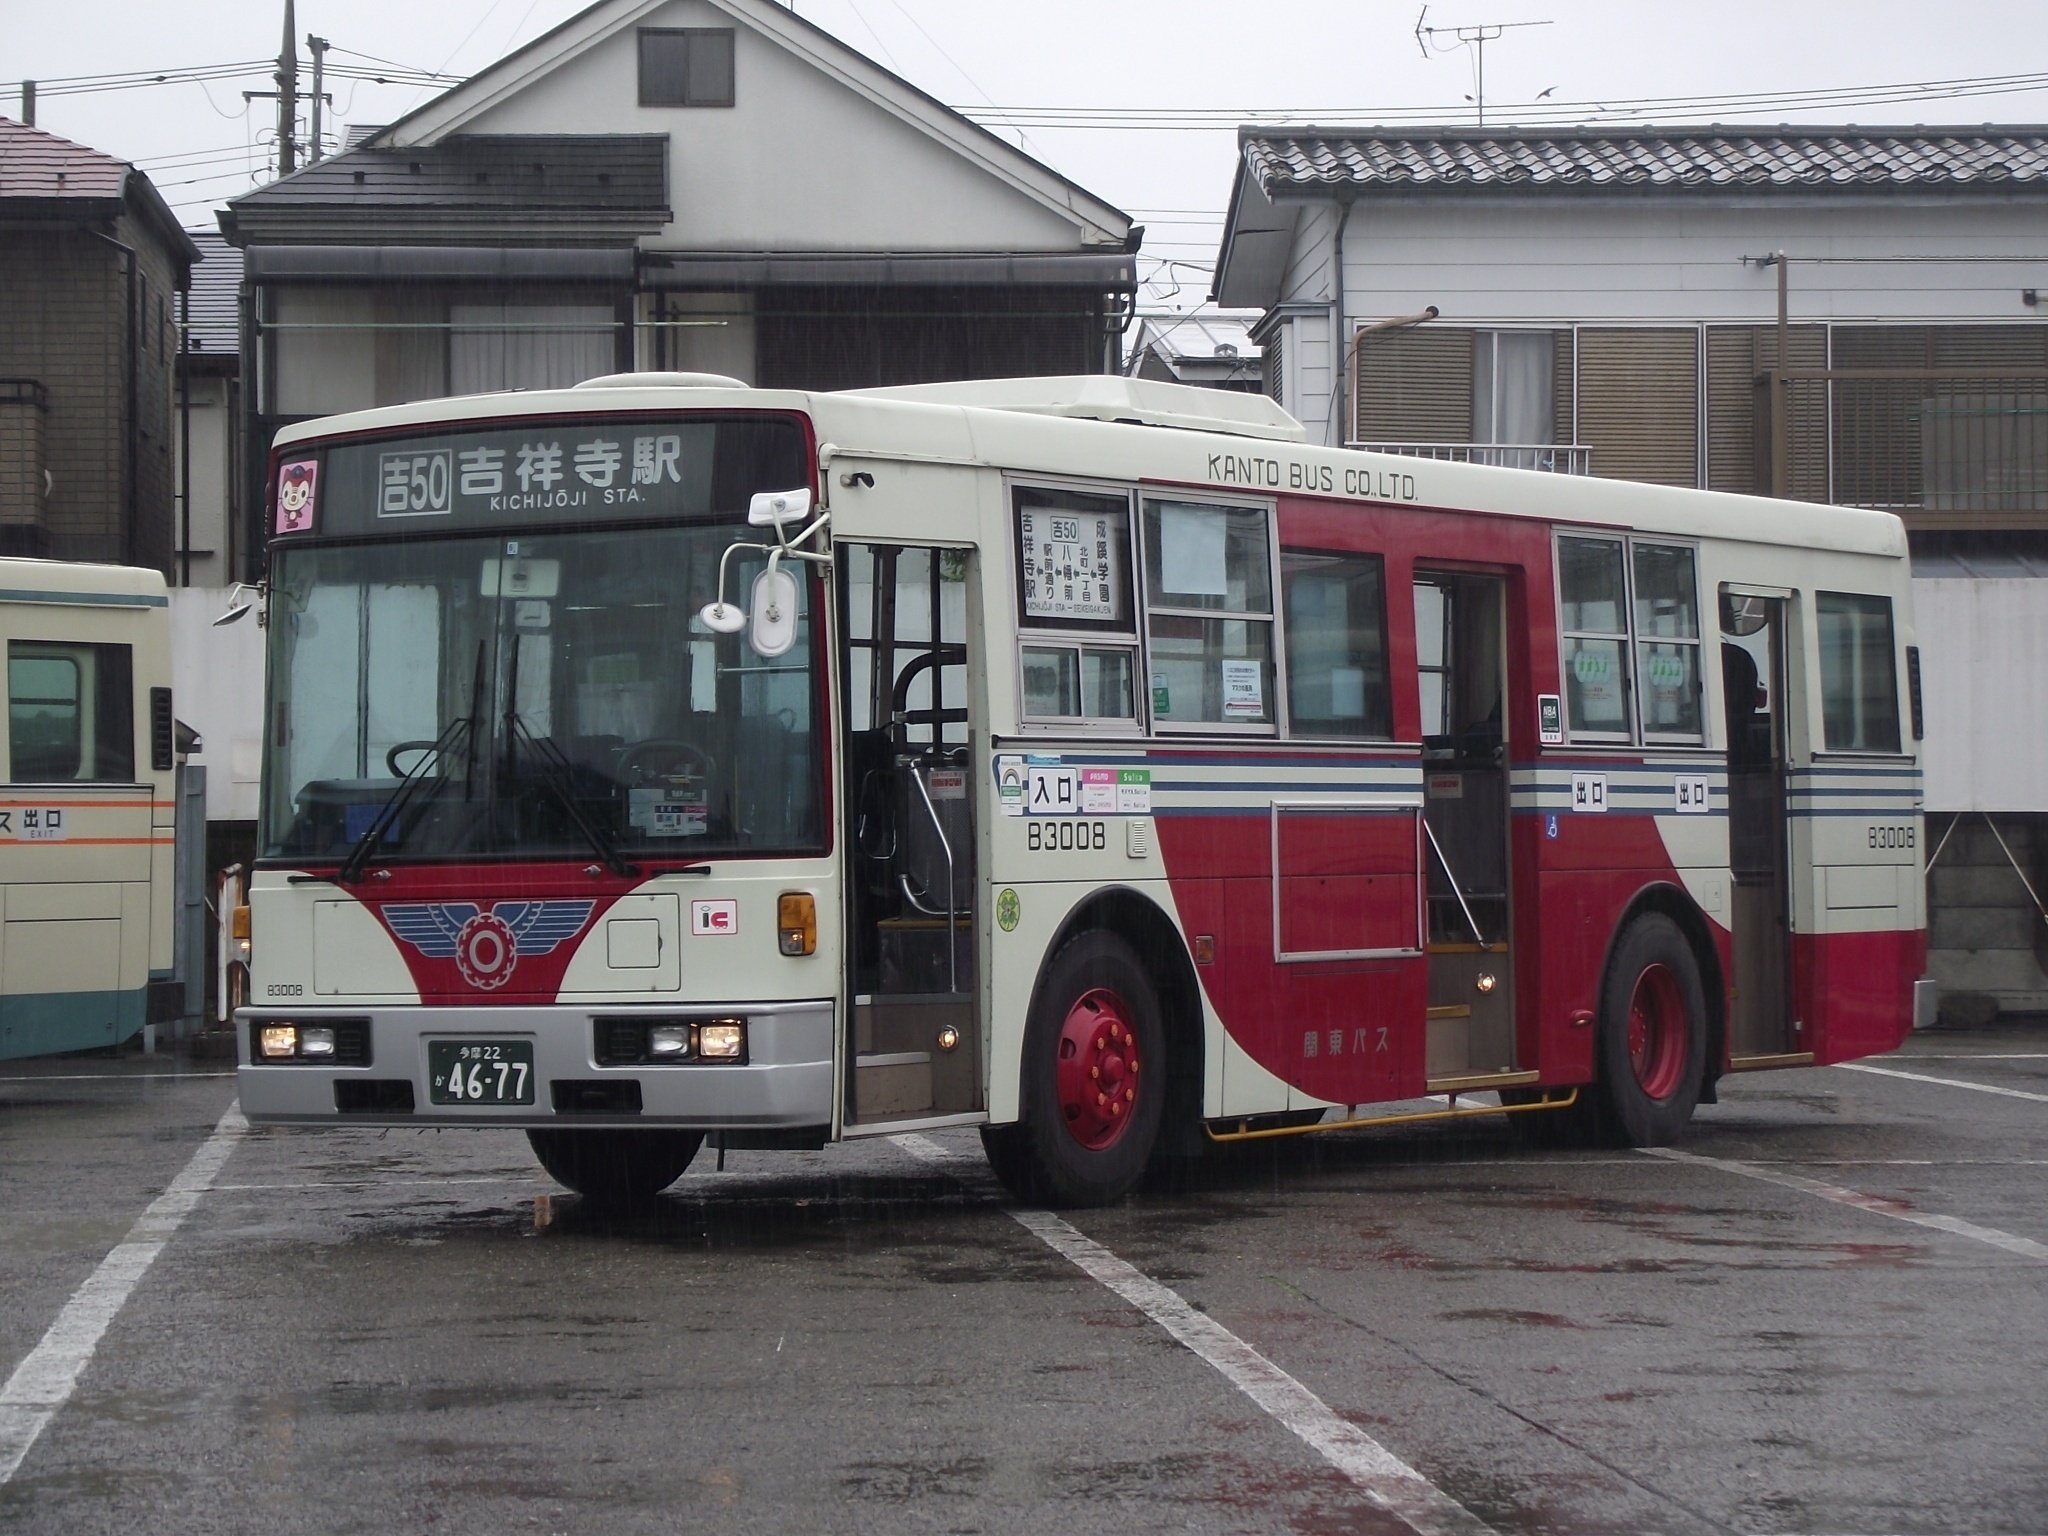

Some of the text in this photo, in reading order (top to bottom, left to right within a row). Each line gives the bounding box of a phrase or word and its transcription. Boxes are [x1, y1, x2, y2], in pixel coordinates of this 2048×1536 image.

[383, 435, 681, 512] 吉50 吉祥寺駅
[1207, 453, 1280, 487] KANTO
[1289, 462, 1333, 492] BUS
[603, 487, 647, 504] STA.
[1052, 520, 1077, 539] 吉50
[1022, 513, 1036, 599] 吉祥寺駅
[1123, 772, 1143, 782] Suica
[1034, 776, 1071, 804] 入口
[1576, 781, 1602, 805] 出口
[1679, 783, 1704, 805] 出口
[24, 809, 61, 828] 出口
[30, 829, 54, 839] EXIT
[1028, 822, 1105, 850] B3008
[448, 1062, 528, 1099] 46-77
